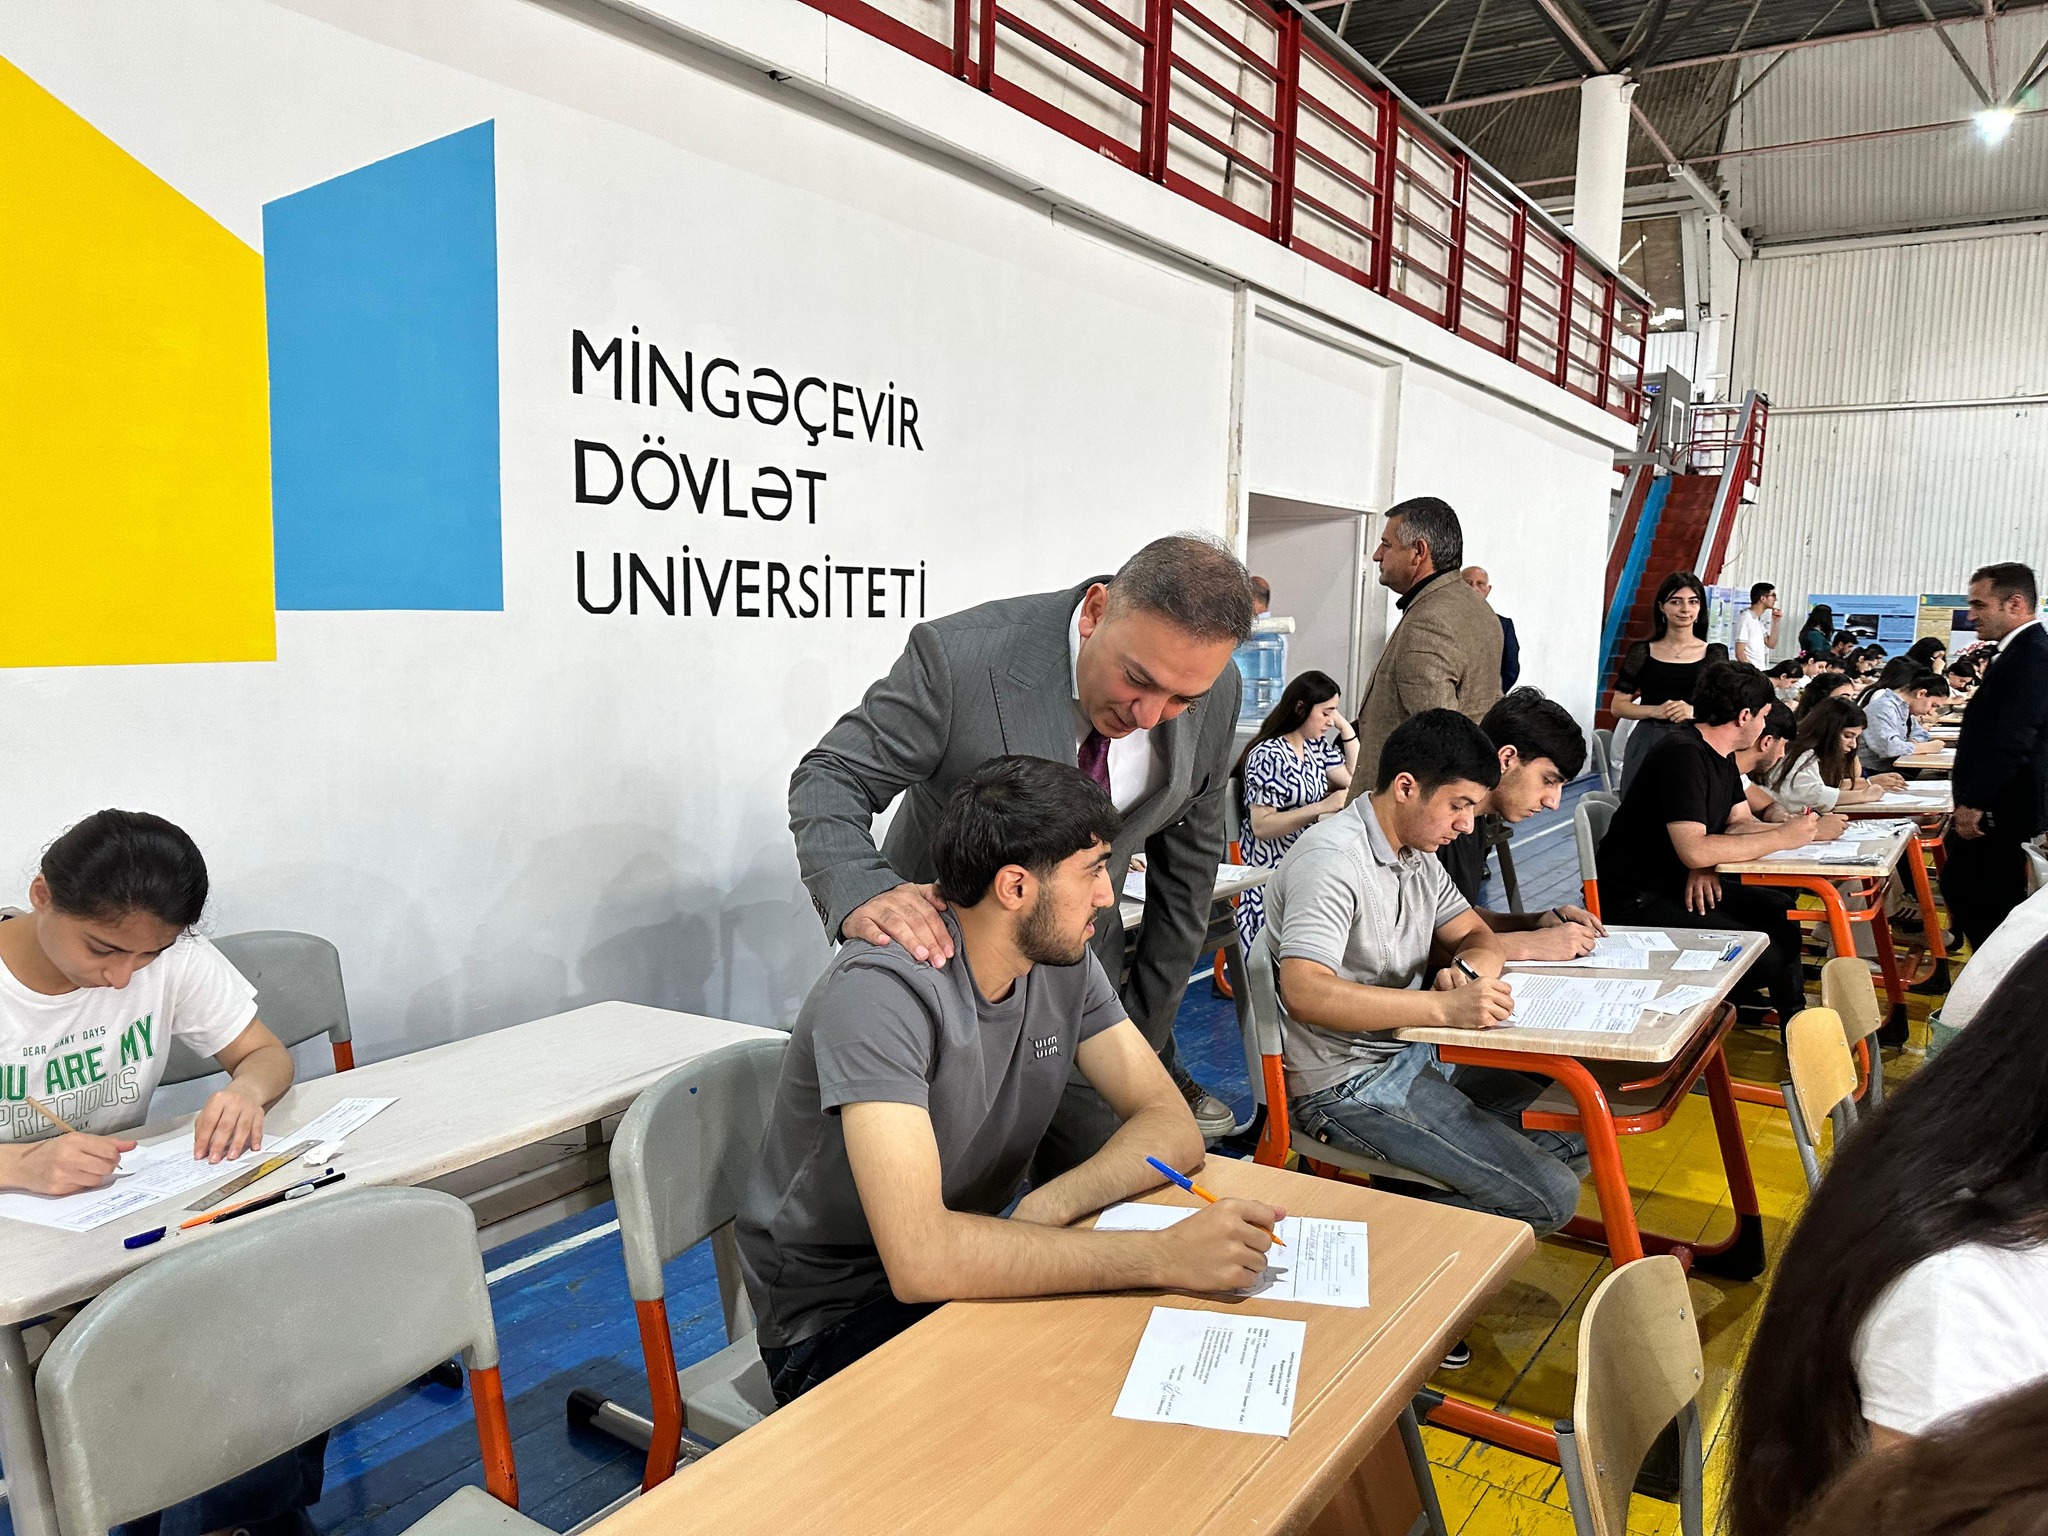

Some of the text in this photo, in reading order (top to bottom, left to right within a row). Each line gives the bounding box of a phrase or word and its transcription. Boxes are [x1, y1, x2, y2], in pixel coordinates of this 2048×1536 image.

[572, 325, 924, 451] MİNGƏÇEVİR
[574, 433, 827, 524] DÖVLƏT
[576, 544, 925, 618] UNİVERSİTETİ
[23, 1044, 47, 1057] DEAR
[83, 1026, 106, 1040] DAYS
[46, 1043, 108, 1096] ARE
[120, 1012, 153, 1067] MY
